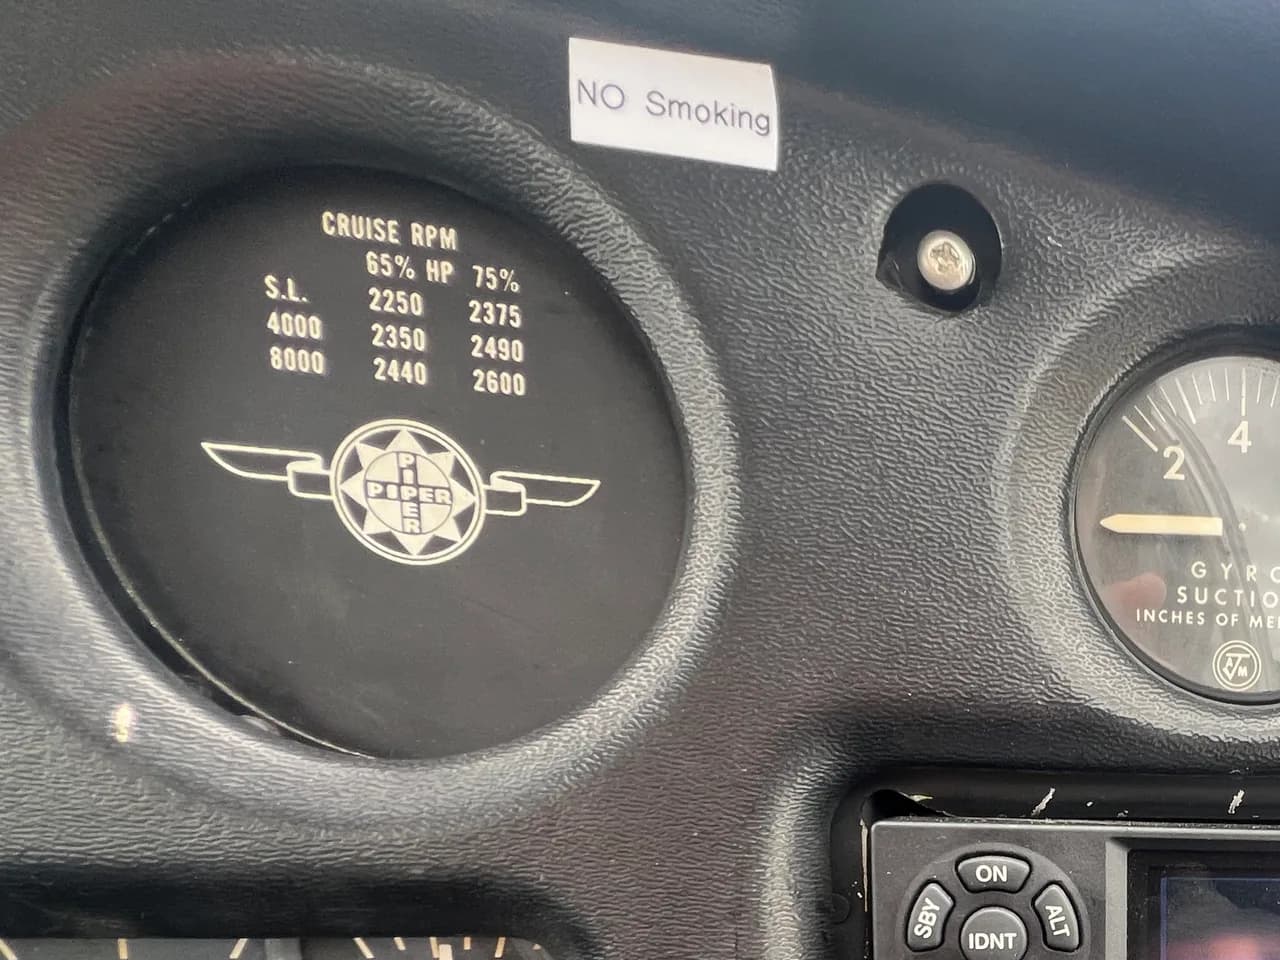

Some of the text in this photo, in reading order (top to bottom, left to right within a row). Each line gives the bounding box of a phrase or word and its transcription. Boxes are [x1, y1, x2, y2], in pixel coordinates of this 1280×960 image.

[577, 79, 771, 136] NO Smoking
[321, 210, 458, 251] CRUISE RPM
[366, 251, 520, 293] 65% HP 75%
[264, 275, 521, 328] S.L. 2250 2375
[267, 311, 524, 362] 4000 2350 2490
[270, 346, 526, 396] 8000 2440 2600
[1228, 421, 1252, 454] 4
[1163, 446, 1185, 480] 2
[367, 481, 453, 505] PIPER
[1136, 608, 1205, 626] INCHES
[1216, 612, 1239, 628] OF
[975, 864, 1008, 883] ON
[914, 897, 941, 940] SBY
[1044, 902, 1071, 939] ALT
[967, 932, 1017, 951] IDNT
